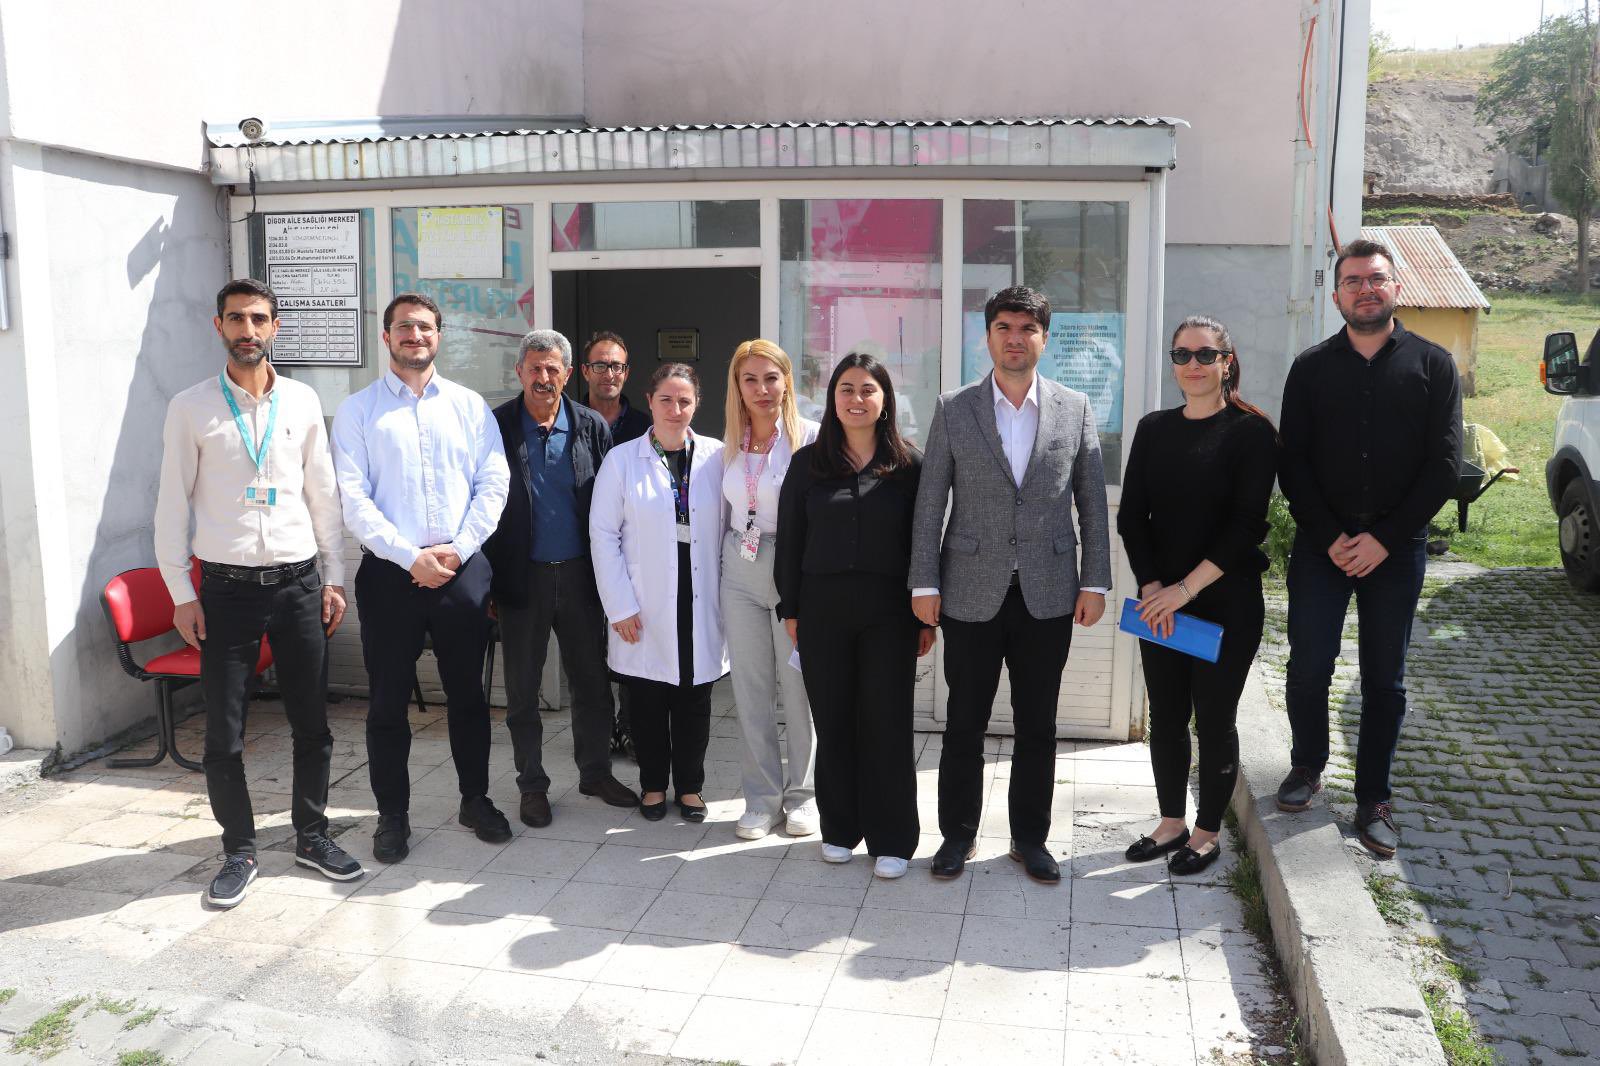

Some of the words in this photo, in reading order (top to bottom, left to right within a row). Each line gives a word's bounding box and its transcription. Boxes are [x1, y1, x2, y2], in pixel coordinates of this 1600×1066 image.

[267, 216, 286, 225] DİGOR
[287, 216, 301, 224] AİLE
[302, 216, 327, 224] SAĞLIĞI
[328, 215, 356, 223] MERKEZİ
[279, 299, 311, 308] ÇALIŞMA
[311, 298, 346, 307] SAATLERİ
